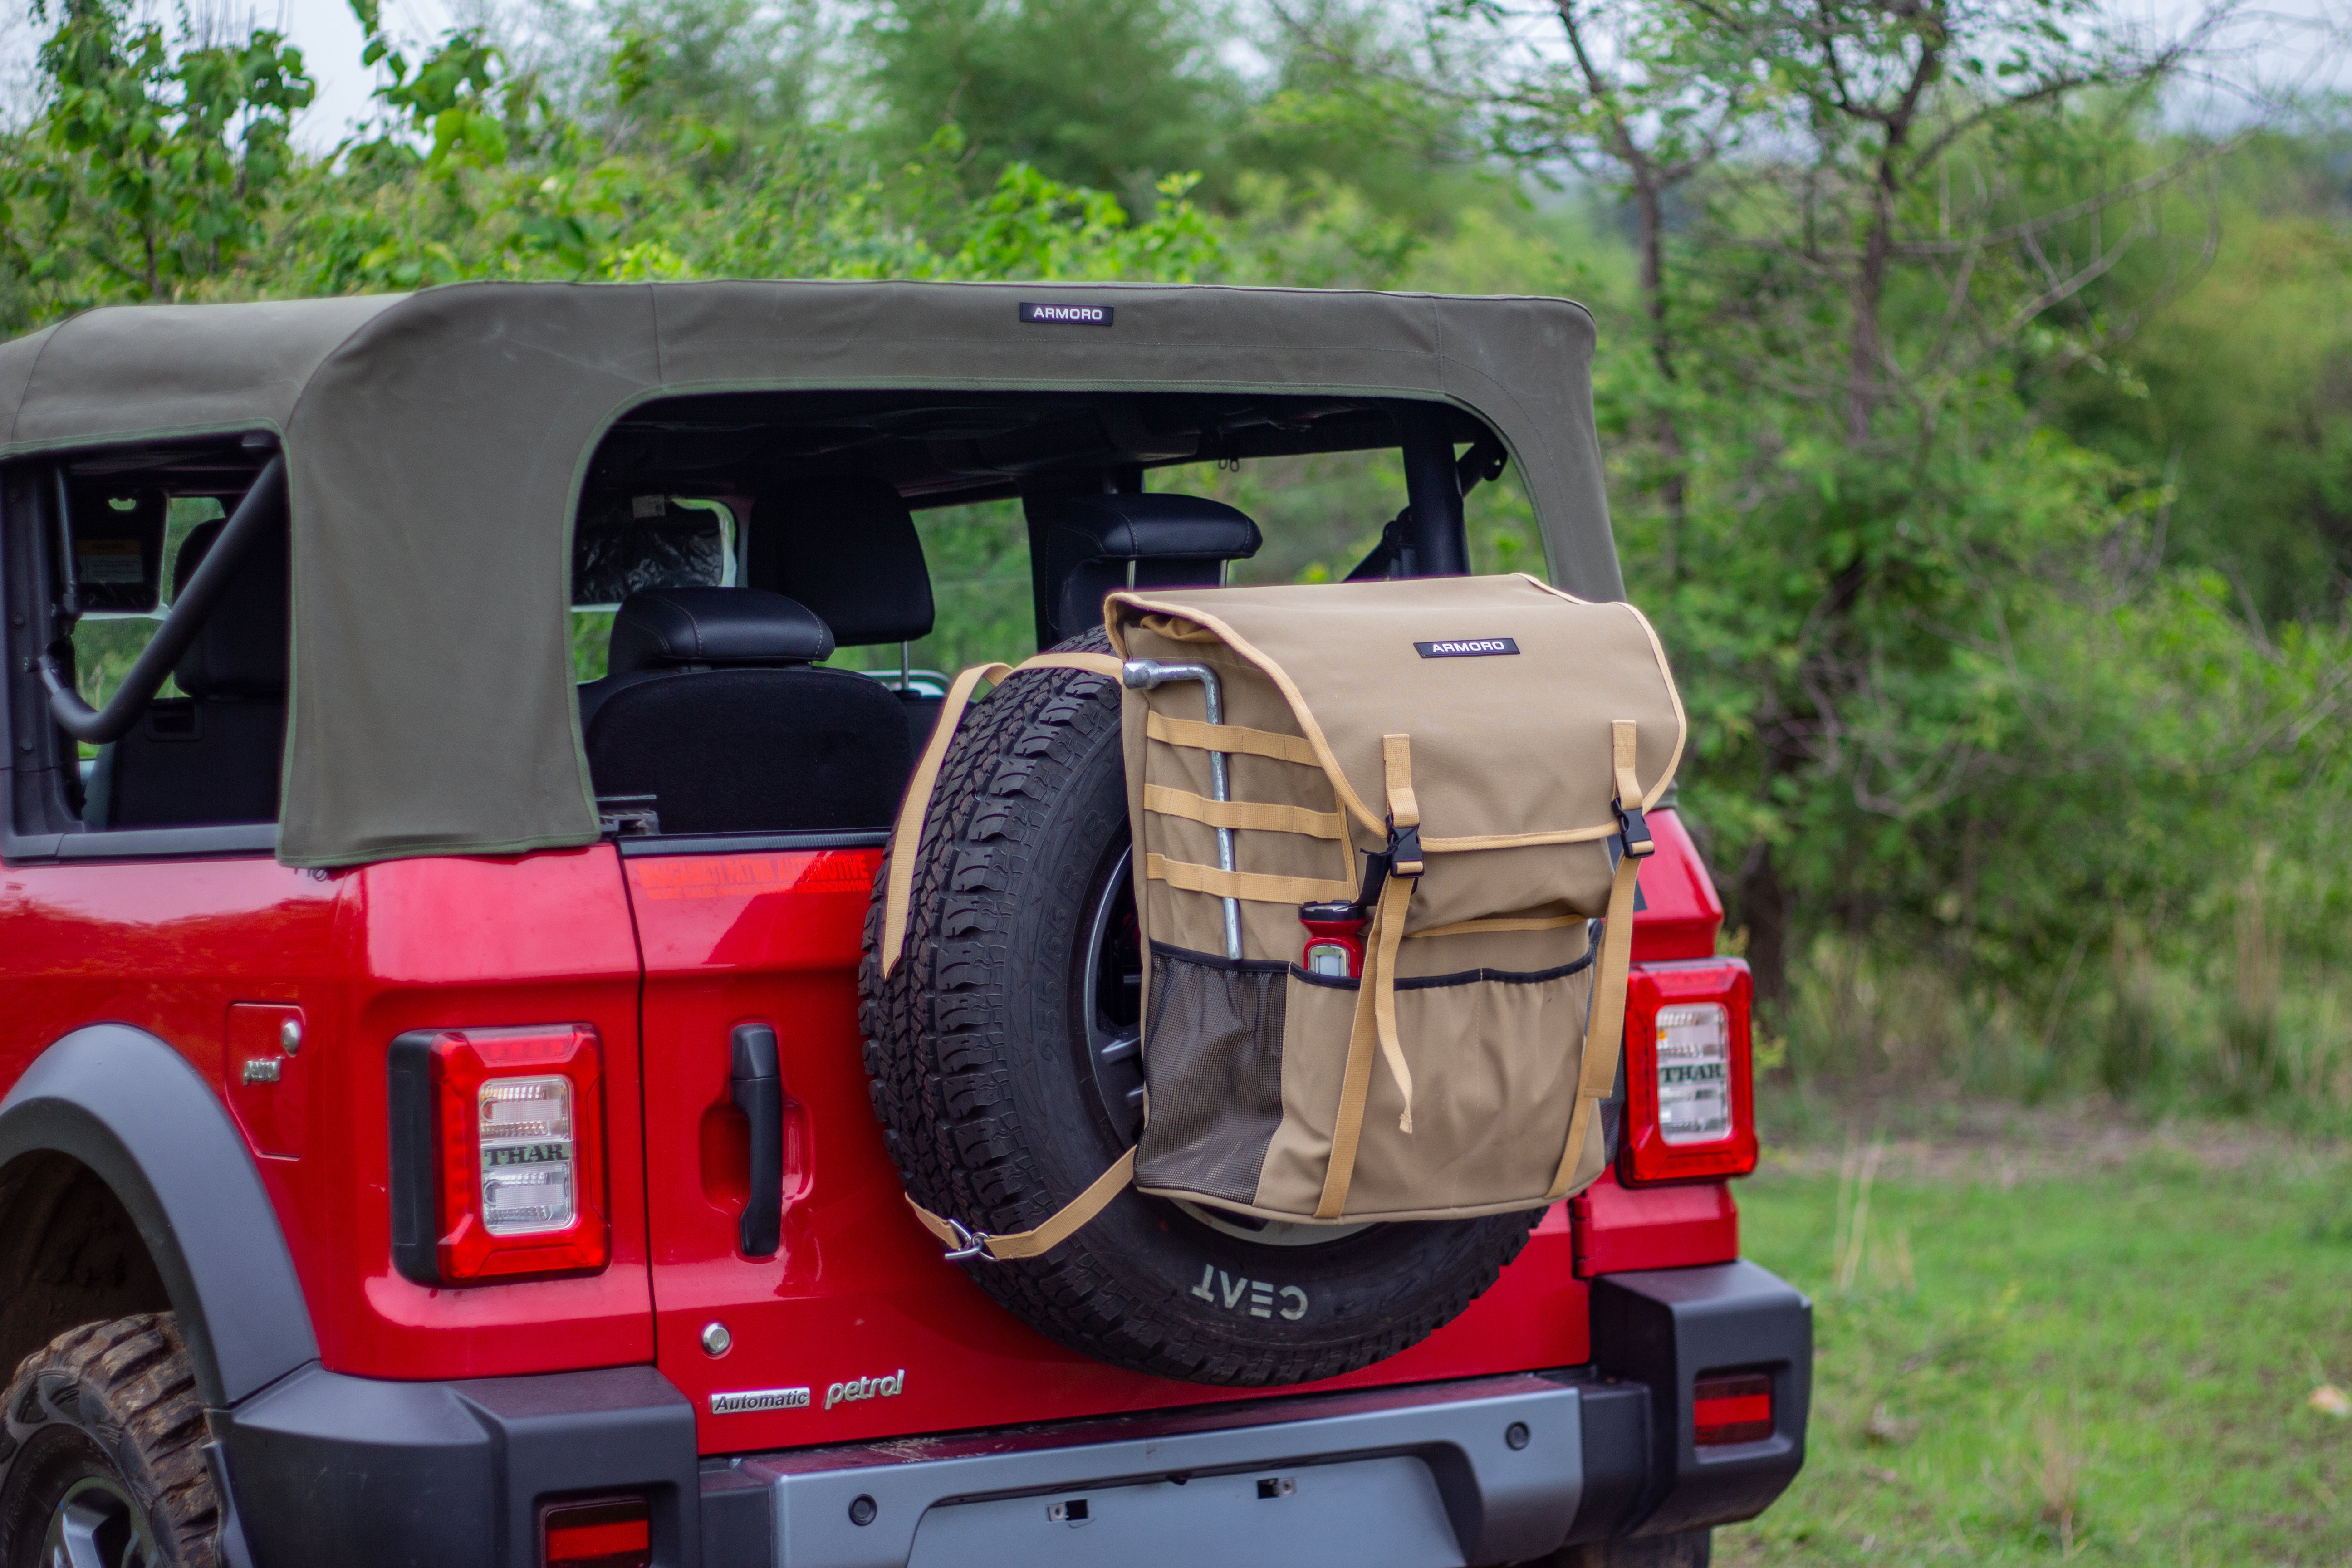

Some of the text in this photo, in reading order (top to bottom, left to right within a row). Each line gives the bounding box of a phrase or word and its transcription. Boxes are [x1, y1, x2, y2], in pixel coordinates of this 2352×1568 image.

[1033, 307, 1102, 320] ARMORO
[1432, 641, 1505, 653] ARMORO
[777, 854, 869, 882] AUTOMOTIVE
[1659, 1063, 1726, 1083] THAR
[483, 1144, 570, 1166] THAR
[1191, 1264, 1308, 1321] CEAT
[715, 1368, 906, 1411] Automatic petrol
